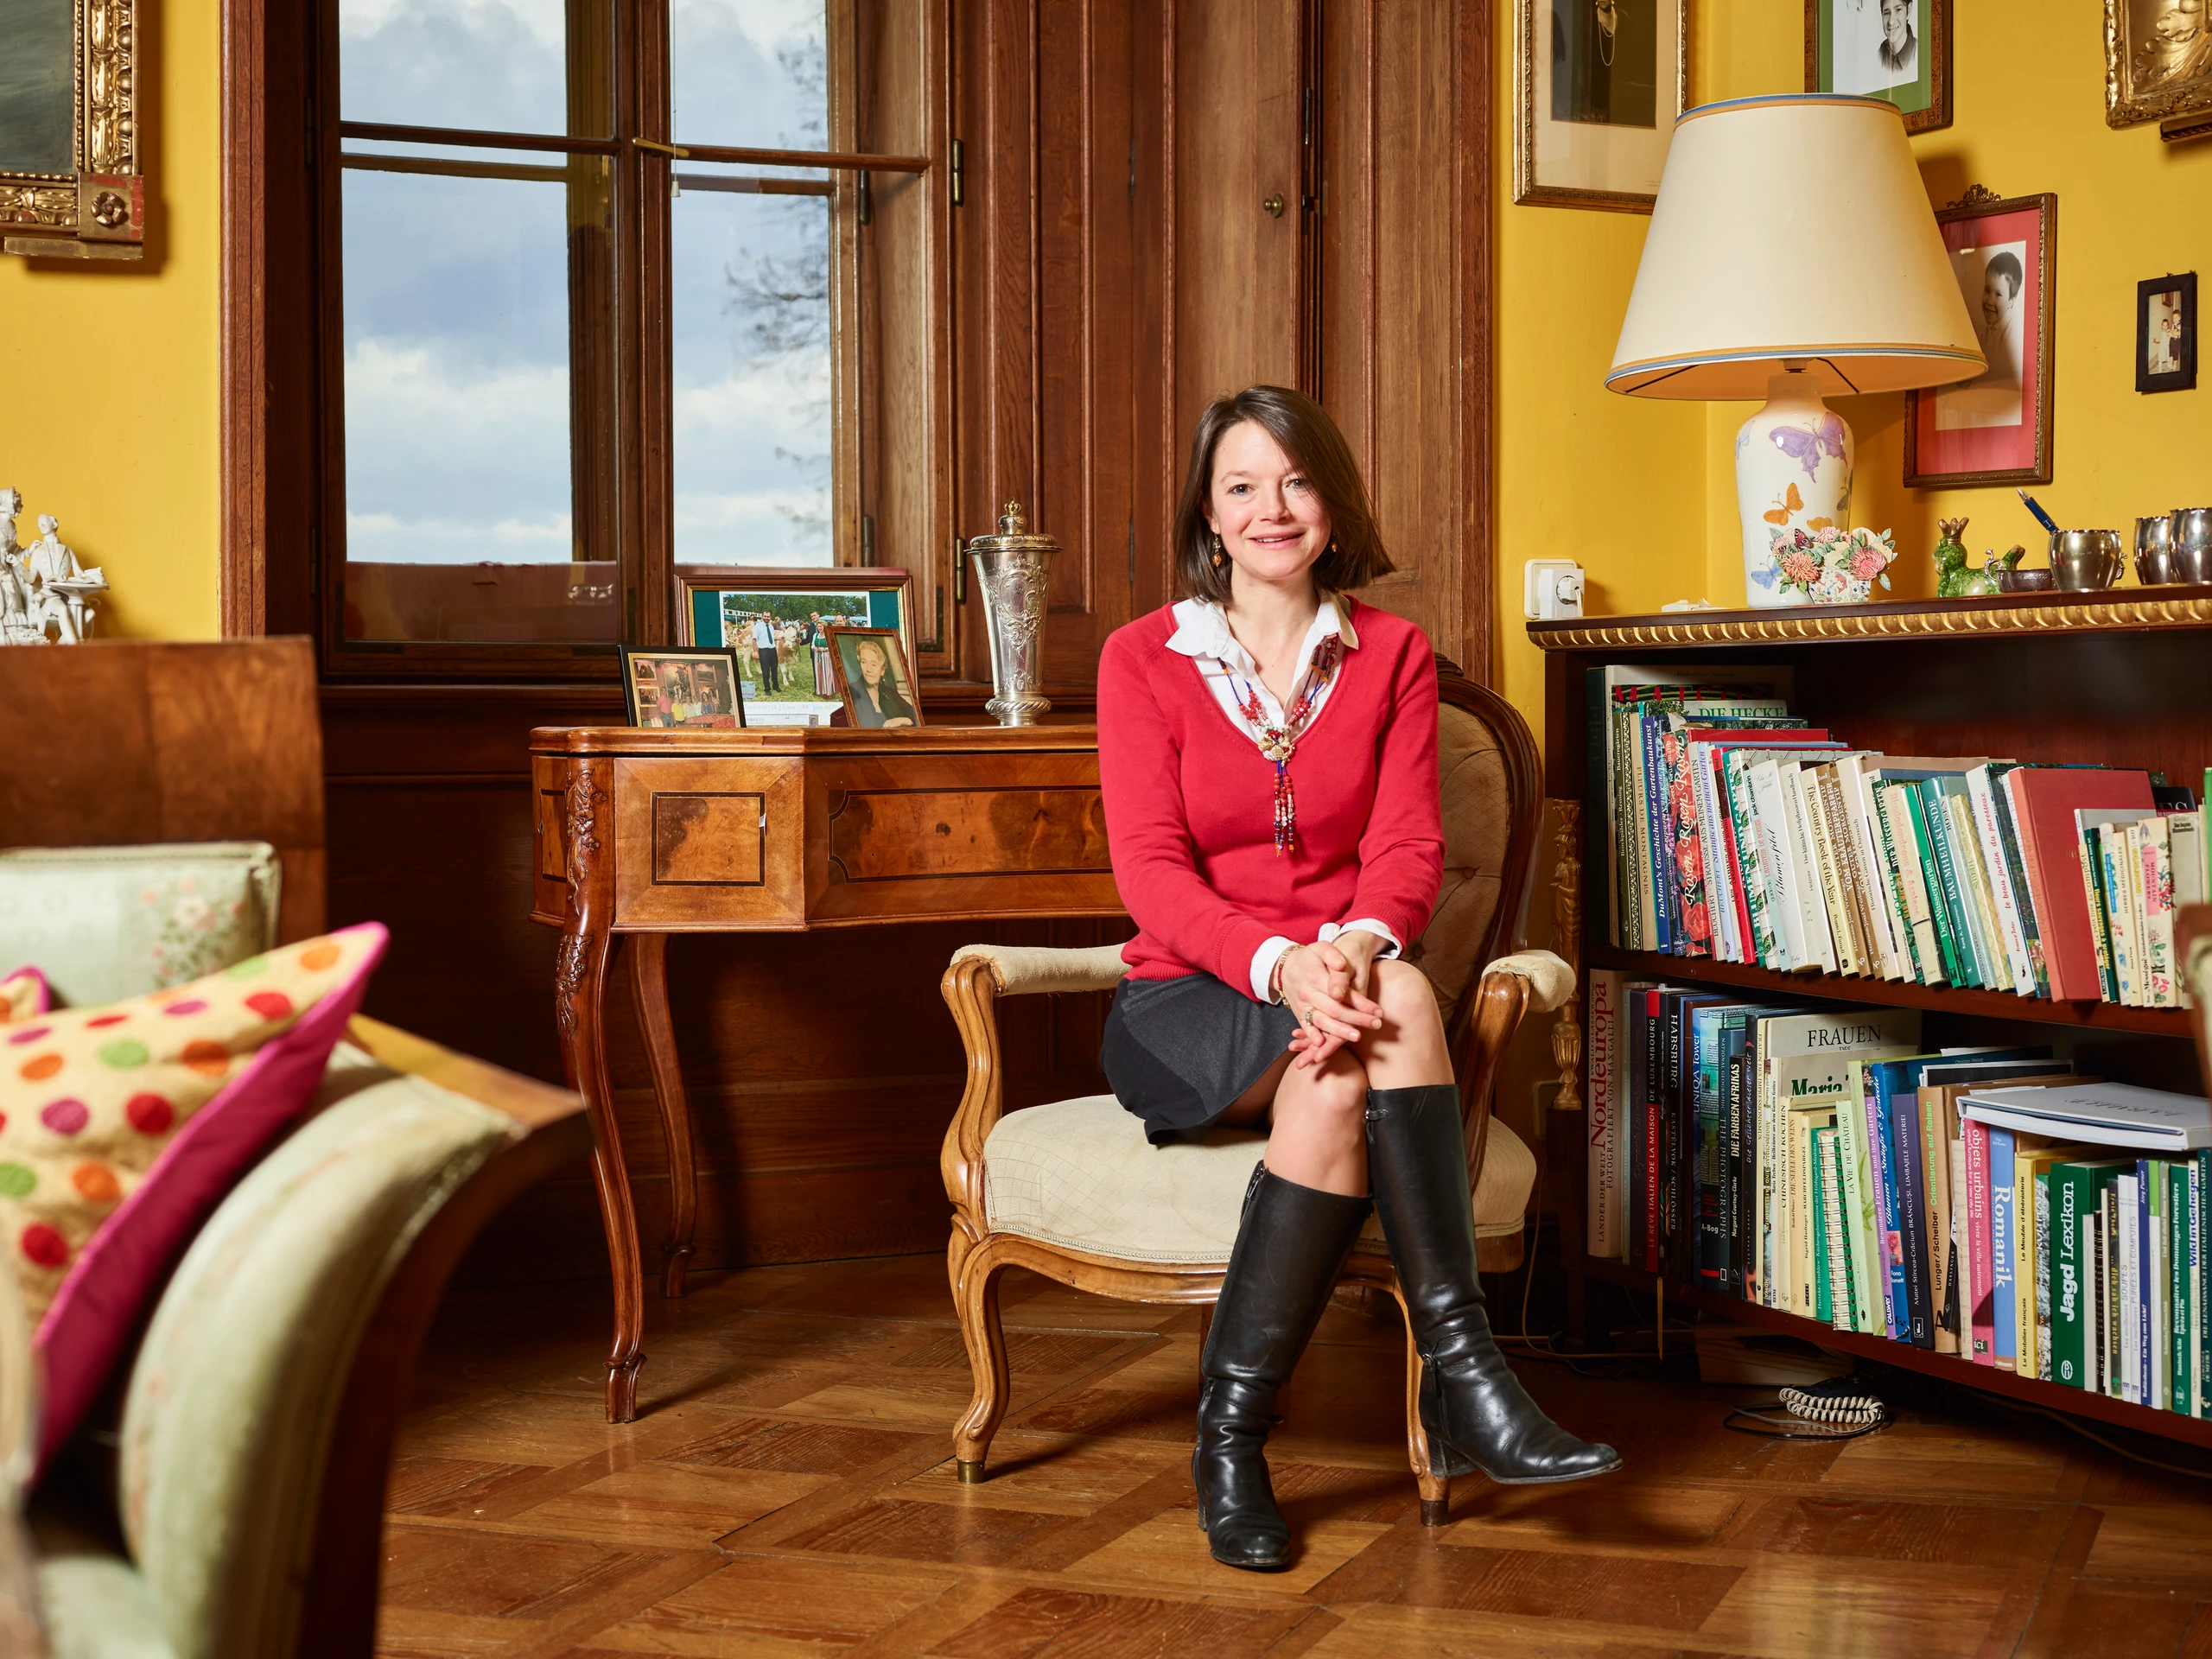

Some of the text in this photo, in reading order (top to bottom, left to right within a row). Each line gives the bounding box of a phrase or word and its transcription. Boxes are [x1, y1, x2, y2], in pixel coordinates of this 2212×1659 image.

[1699, 707, 1784, 716] DIE HECKE
[1691, 759, 1702, 792] GARTEN
[1644, 724, 1666, 918] DuMont's Geschichte der Gartenbaukunst
[1673, 735, 1697, 906] Rosen Rosen Rosen
[1694, 792, 1704, 826] MEINEM
[1751, 804, 1759, 817] jack
[1834, 787, 1849, 843] MORGENTIP
[1940, 799, 1952, 832] ROSEN
[1980, 791, 1994, 832] paresseux
[1637, 766, 1649, 895] FLEURS DE MONTAGNES
[1698, 827, 1707, 843] AUS
[1807, 783, 1836, 906] The Country Book of the Year
[1890, 791, 1911, 867] Rhododendrons
[1989, 835, 1998, 848] du
[1928, 798, 1957, 901] BAUMHEILKUNDE
[1993, 850, 2006, 878] jardin
[1843, 873, 1853, 892] VOM
[2117, 847, 2126, 888] MÉDICINALES
[2132, 848, 2143, 893] MOEWIG
[1923, 859, 1948, 938] Der Wassergarten
[1999, 879, 2009, 899] beau
[2003, 901, 2012, 910] le
[1708, 894, 1719, 937] BEUCHERT
[1846, 909, 1859, 952] Hermann-Josef
[1670, 1014, 1679, 1088] HABSBURG
[1808, 1024, 1882, 1047] FRAUEN
[1590, 981, 1614, 1152] Nordeuropa
[1649, 1089, 1656, 1102] DE
[1730, 1064, 1740, 1158] DIE FARBEN AFRIKAS
[1872, 1075, 1885, 1119] Gestecke
[1841, 1113, 1851, 1152] CHÂTEAU
[1865, 1103, 1875, 1137] Gärten
[1900, 1114, 1909, 1148] MATERIEI
[1924, 1101, 1934, 1132] Reisen
[1648, 1147, 1656, 1159] LA
[1925, 1133, 1935, 1148] auf
[1972, 1128, 1984, 1167] objets
[1648, 1160, 1656, 1173] DE
[1845, 1154, 1852, 1166] DE
[1869, 1154, 1878, 1169] und
[1903, 1150, 1912, 1187] LIMBAJELE
[1847, 1184, 1855, 1194] LA
[1871, 1171, 1882, 1205] Frauen
[1926, 1151, 1937, 1206] Orientierung
[1973, 1171, 1985, 1218] urbains
[1883, 1182, 1893, 1227] Blumen
[2189, 1169, 2199, 1226] Gehegen
[1647, 1212, 1656, 1235] RÊVE
[1876, 1207, 1885, 1245] Besondere
[1994, 1185, 2013, 1288] Romanik
[2189, 1227, 2196, 1238] in
[1648, 1236, 1655, 1248] LE
[2020, 1252, 2026, 1262] Le
[2059, 1181, 2078, 1322] Jagd Lexikon
[2172, 1224, 2182, 1270] Dommages
[2189, 1240, 2197, 1267] Wild
[2130, 1262, 2137, 1270] ET
[1974, 1338, 1984, 1350] ici
[2022, 1358, 2028, 1368] Le
